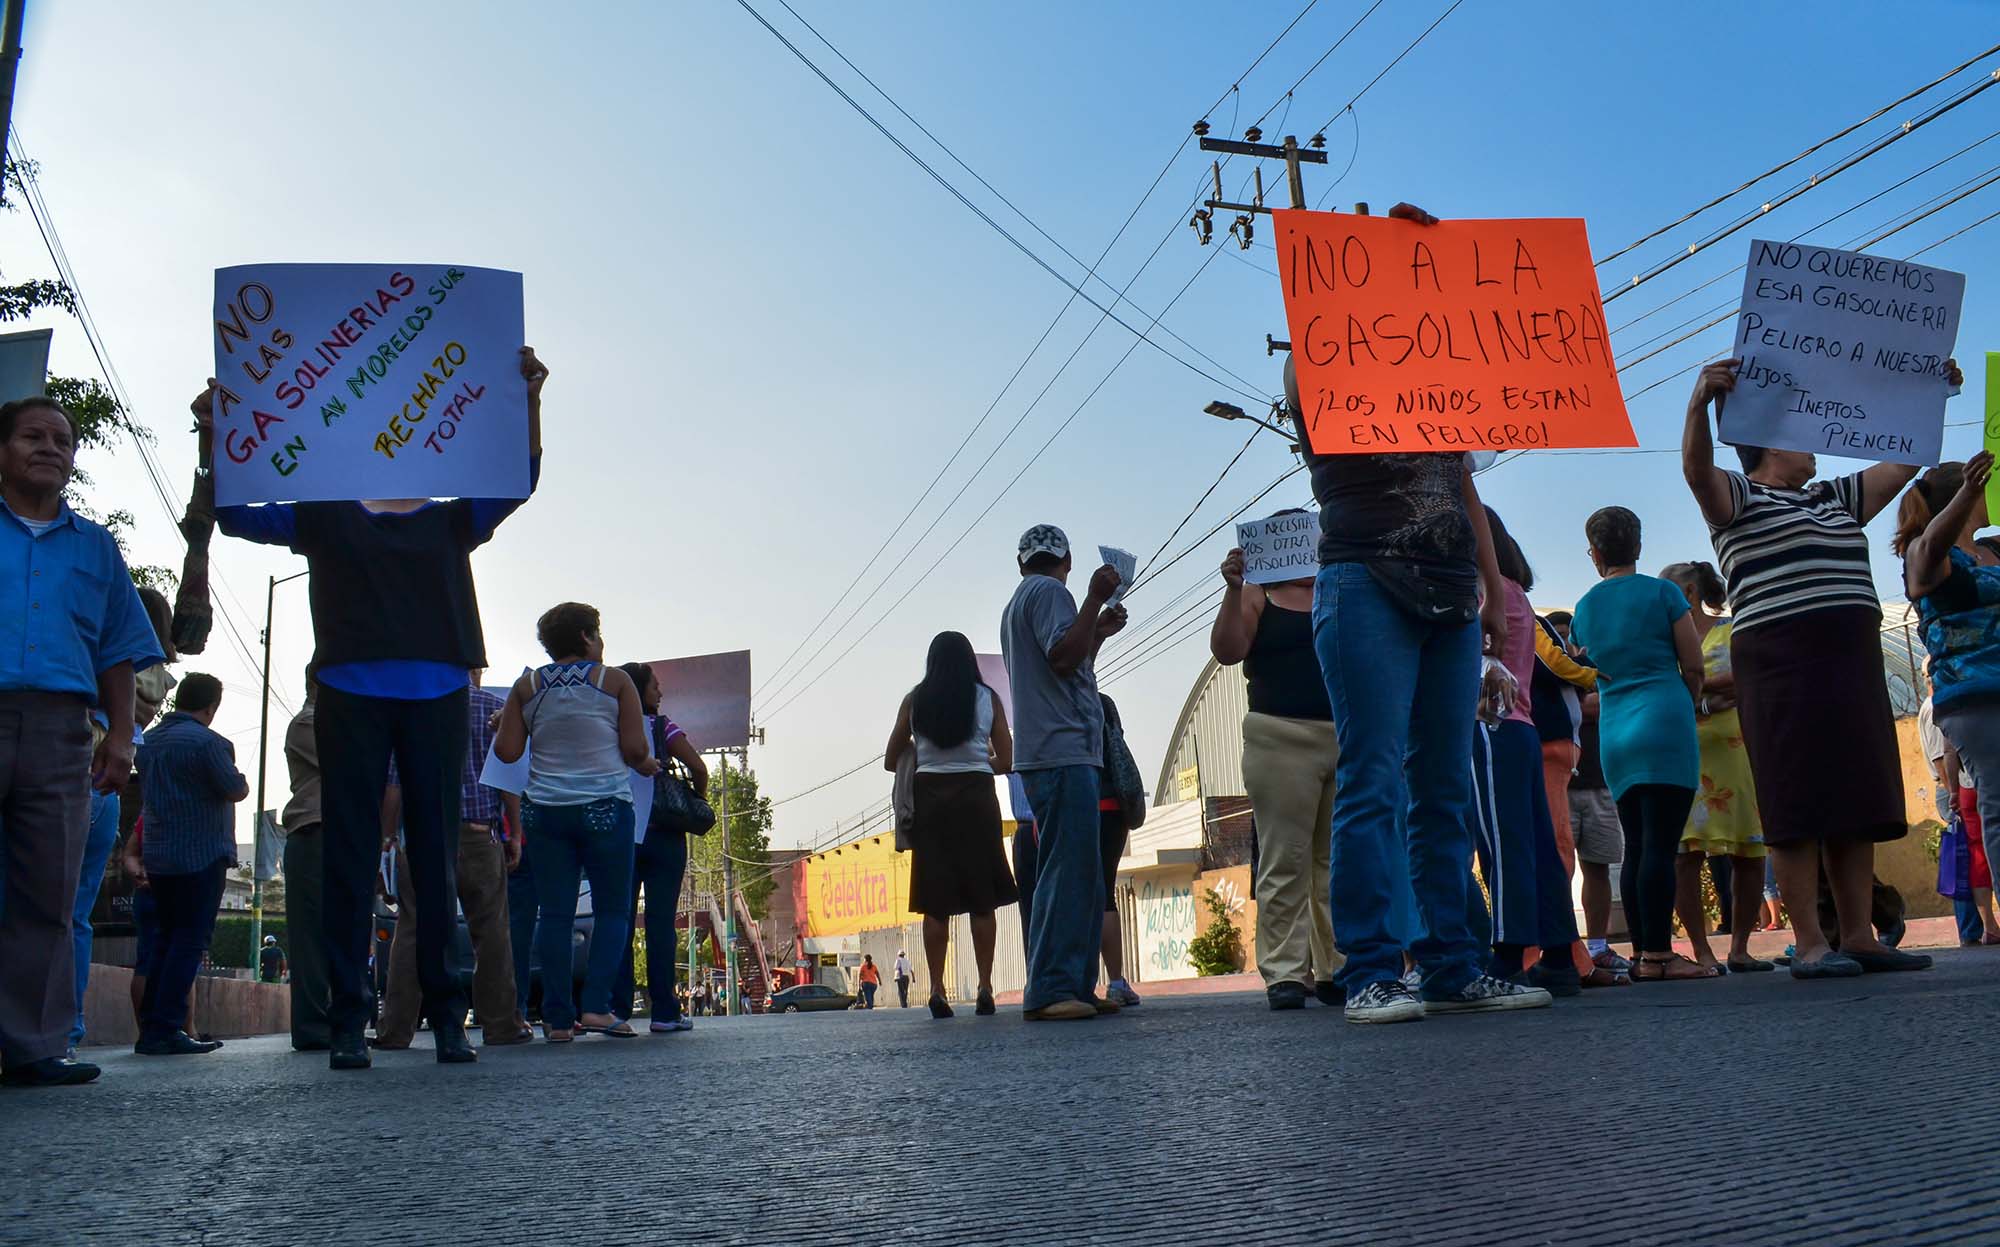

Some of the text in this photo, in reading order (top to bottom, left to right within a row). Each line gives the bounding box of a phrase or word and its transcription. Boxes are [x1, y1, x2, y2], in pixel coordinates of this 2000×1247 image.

[1411, 241, 1442, 292] A
[1473, 238, 1542, 294] LA
[1757, 242, 1935, 293] NO QUEREMOS
[215, 281, 274, 353] NO
[1756, 278, 1946, 331] ESA GASOLINERA
[215, 328, 294, 416] A LAS
[270, 435, 307, 476] EN
[345, 304, 432, 399] MORELOS
[428, 268, 465, 304] SUR
[1743, 312, 1953, 380] PELIGRO A NUESTRO
[374, 341, 467, 459] RECHAZO
[423, 382, 486, 454] TOTAL
[1396, 384, 1481, 414] NIÑOS
[1501, 384, 1592, 411] ESTAN
[1787, 389, 1866, 420] INEPTOS
[1350, 422, 1549, 448] EN PELIGRO!
[1240, 525, 1258, 540] NO
[1240, 534, 1311, 557] MOS OTRA
[1244, 550, 1320, 573] GASOLINER
[834, 862, 889, 919] elektra
